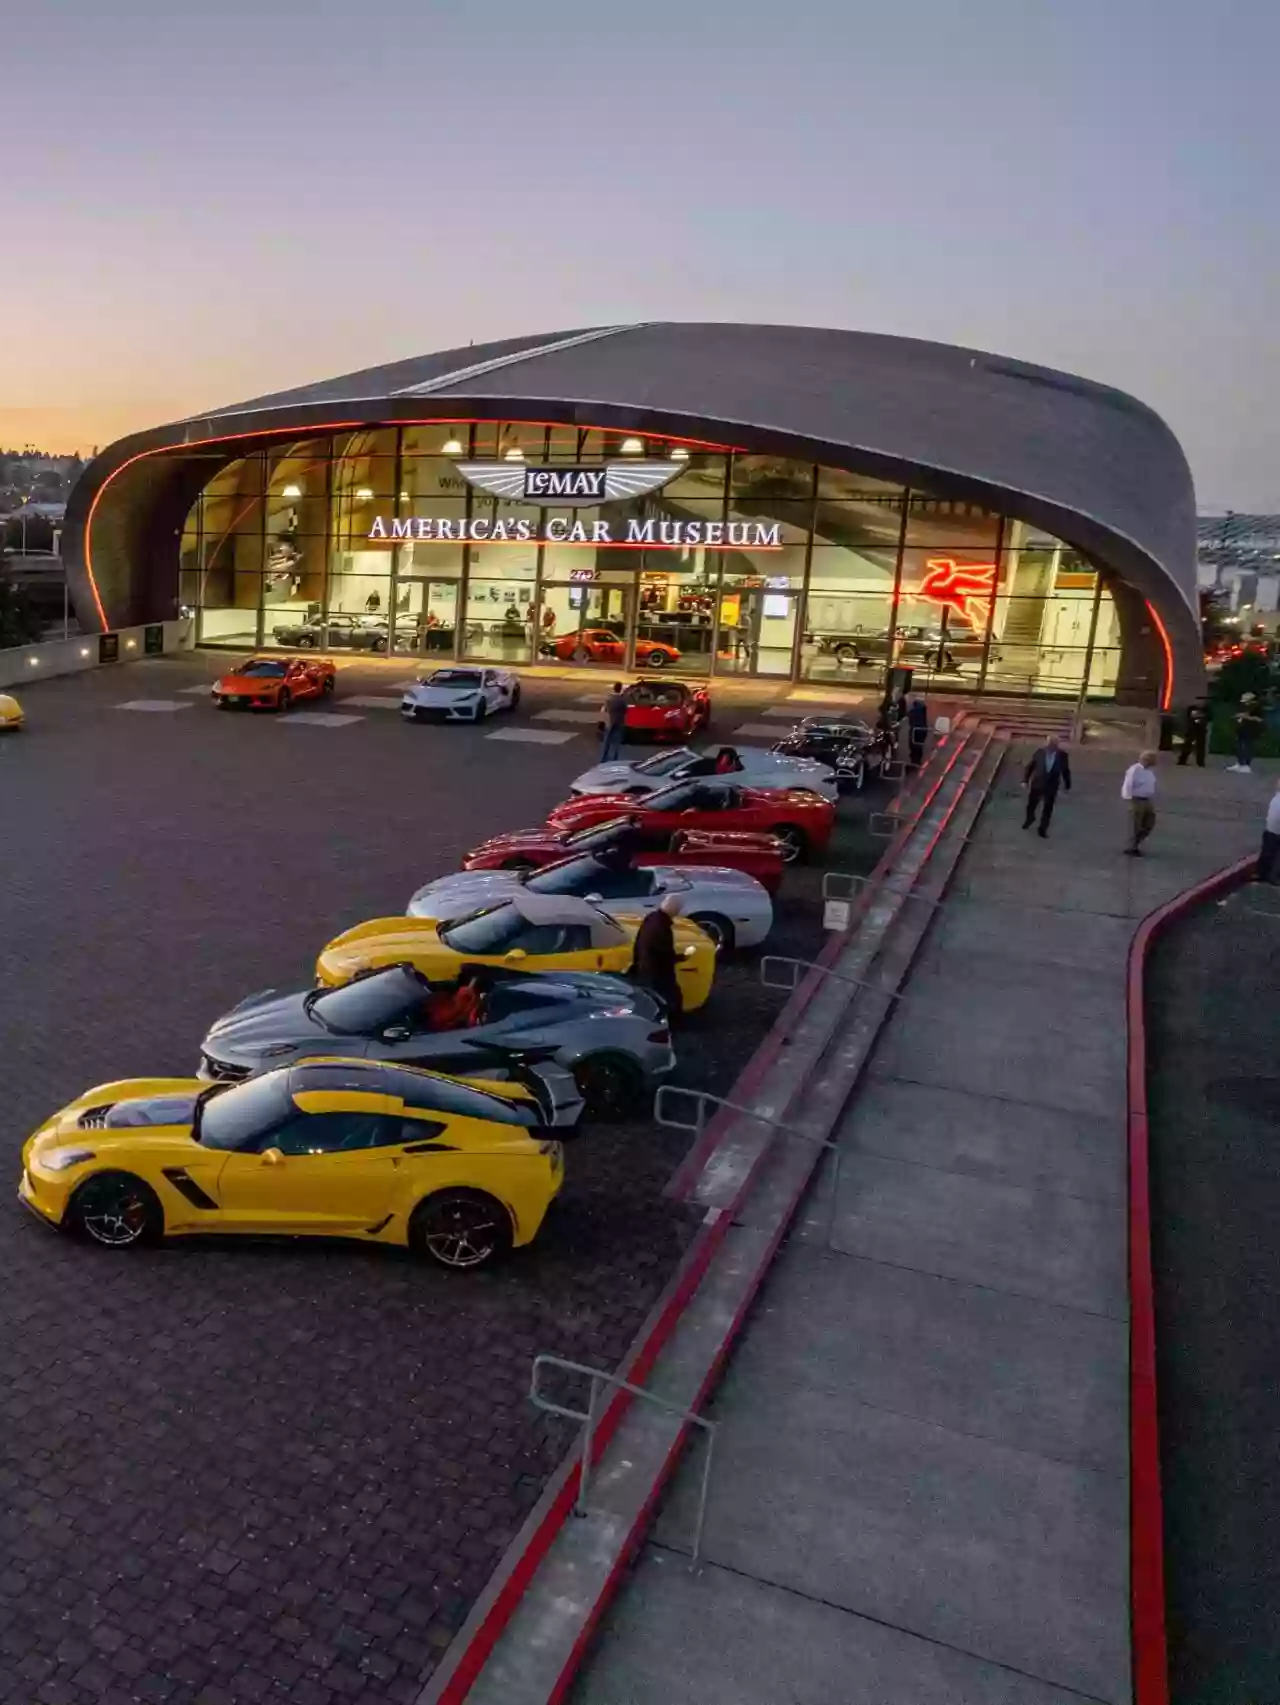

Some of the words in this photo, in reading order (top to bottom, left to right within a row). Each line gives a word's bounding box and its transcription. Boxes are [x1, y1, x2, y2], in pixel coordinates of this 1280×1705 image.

[526, 471, 605, 494] LeMAY
[368, 516, 531, 540] AMERICA'S
[546, 518, 613, 542] CAR
[625, 519, 782, 545] MUSEUM
